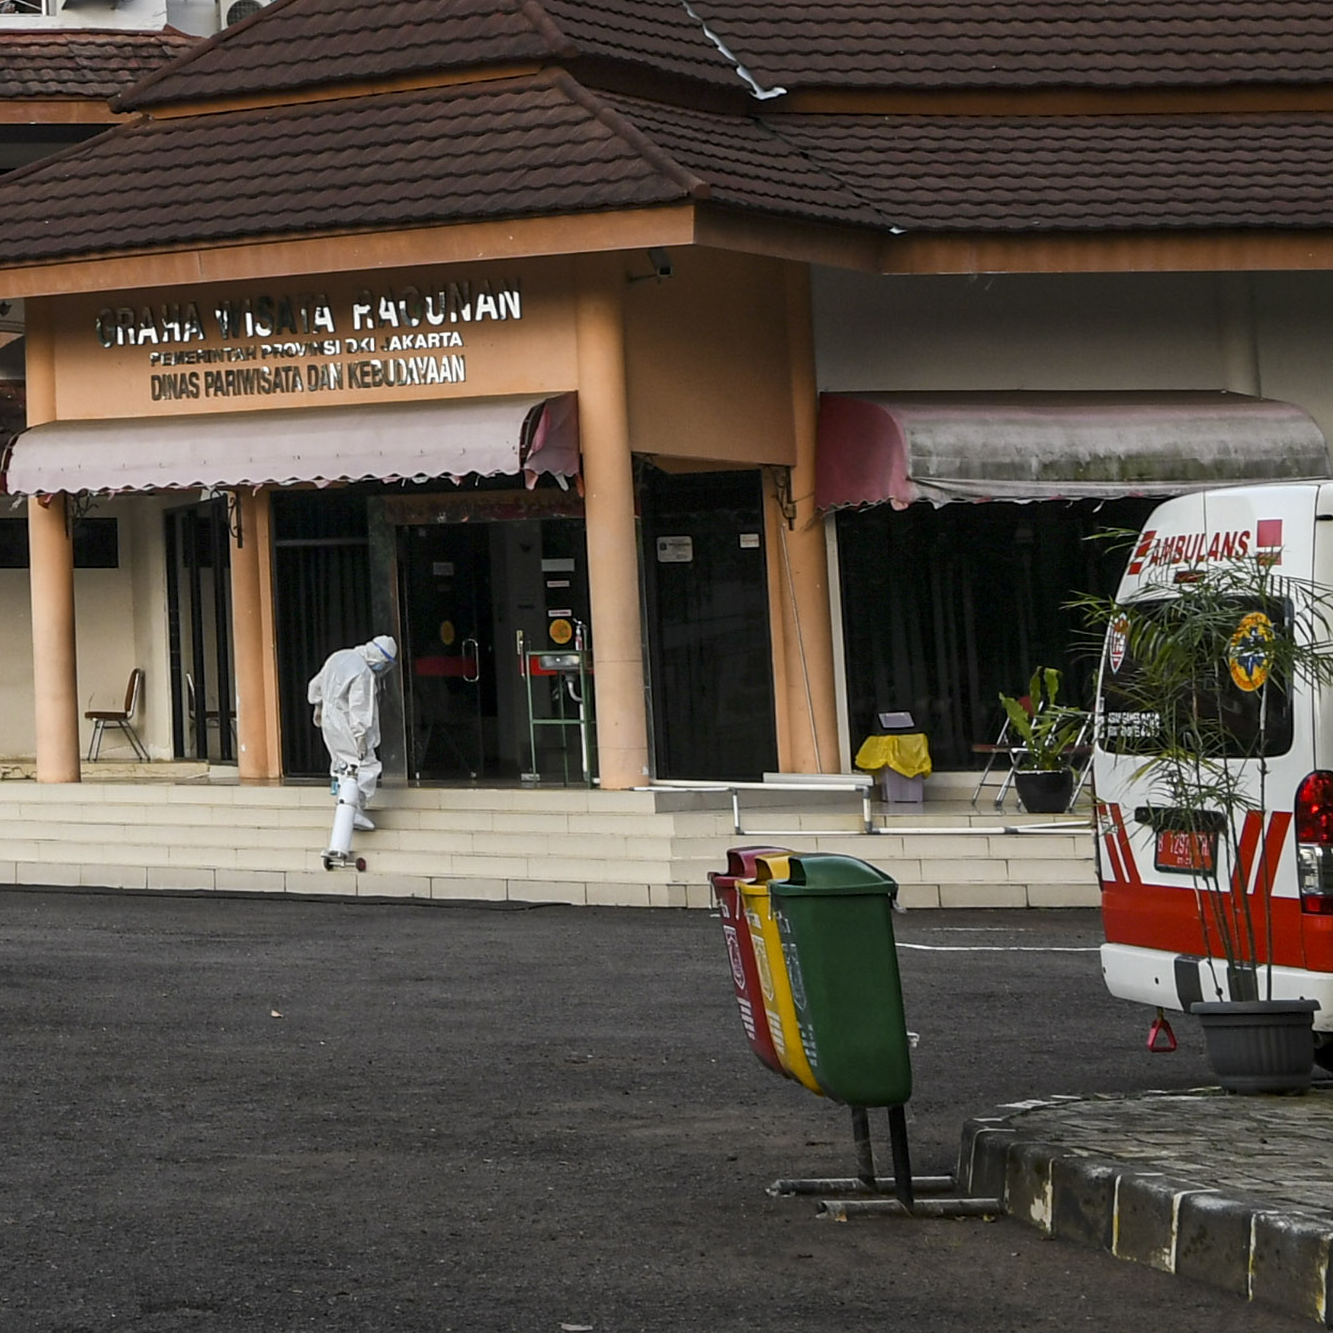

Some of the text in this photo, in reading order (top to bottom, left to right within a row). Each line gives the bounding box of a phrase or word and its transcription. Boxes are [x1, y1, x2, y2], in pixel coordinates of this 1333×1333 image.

[96, 278, 523, 348] GRAHA WISATA RAGUNAN
[149, 331, 464, 367] PEMERINTAH PROVINSI DKI JAKARTA
[151, 354, 467, 401] DINAS PARIWISATA DAN KEBUDAYAAN
[1149, 530, 1251, 567] AMBULANS
